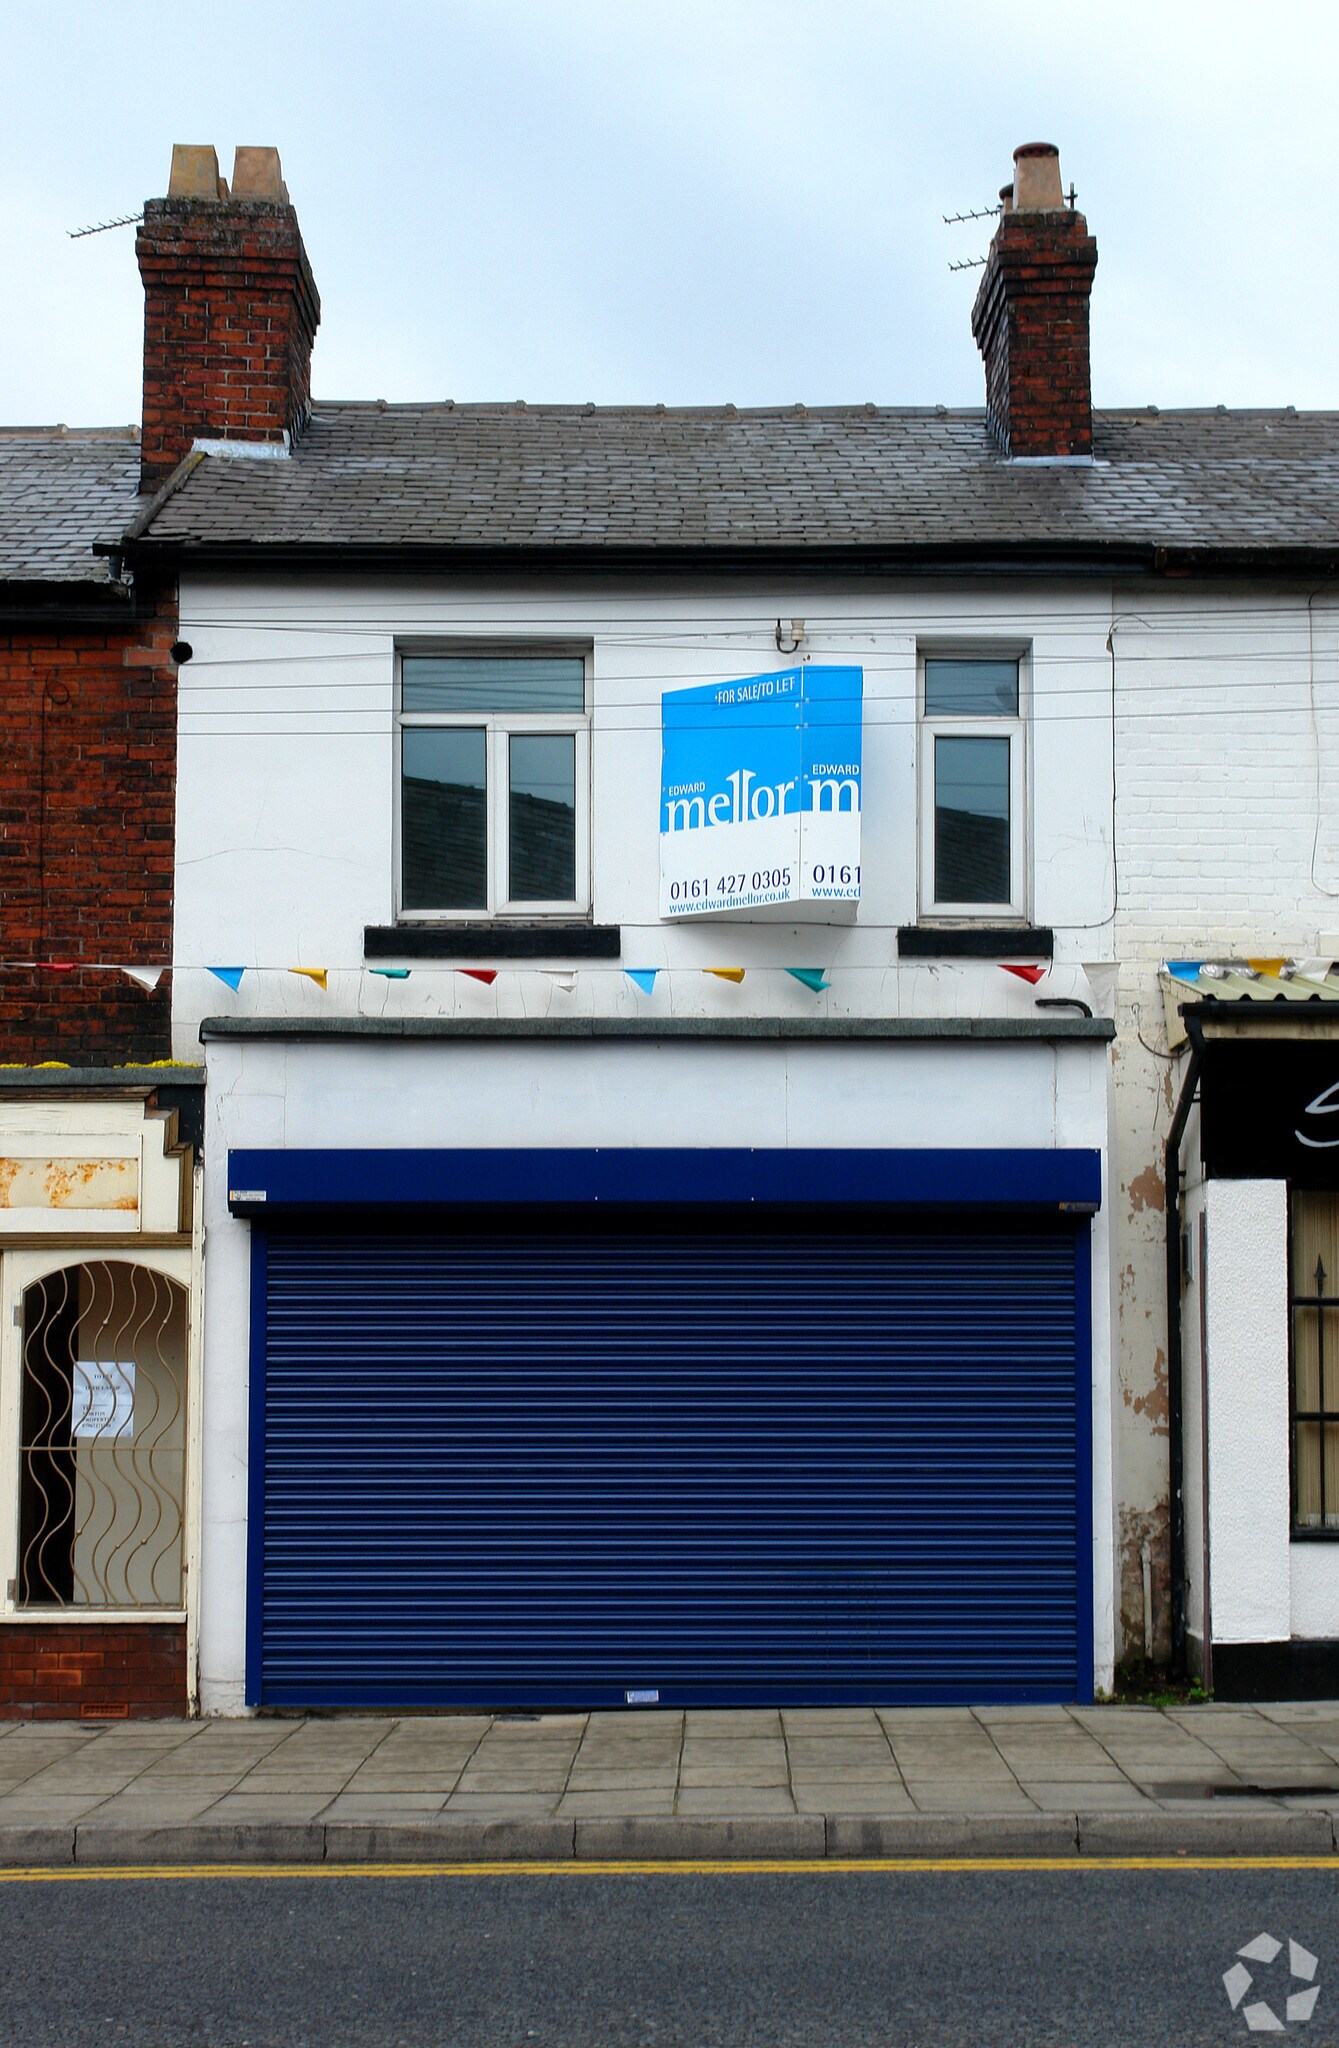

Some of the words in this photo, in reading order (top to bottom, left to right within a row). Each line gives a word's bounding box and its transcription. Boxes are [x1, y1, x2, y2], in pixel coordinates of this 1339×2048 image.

[718, 689, 735, 705] FOR
[737, 681, 774, 702] SALE/TO
[776, 676, 796, 694] LET
[812, 764, 860, 776] EDWARD
[665, 768, 795, 832] mellor
[668, 782, 706, 797] EDWARD
[670, 878, 709, 900] 0161
[716, 874, 746, 895] 427
[751, 867, 791, 890] 0305
[812, 864, 861, 884] 0161
[669, 889, 790, 914] www.edwardmellor.co.uk
[811, 885, 861, 898] www.ed
